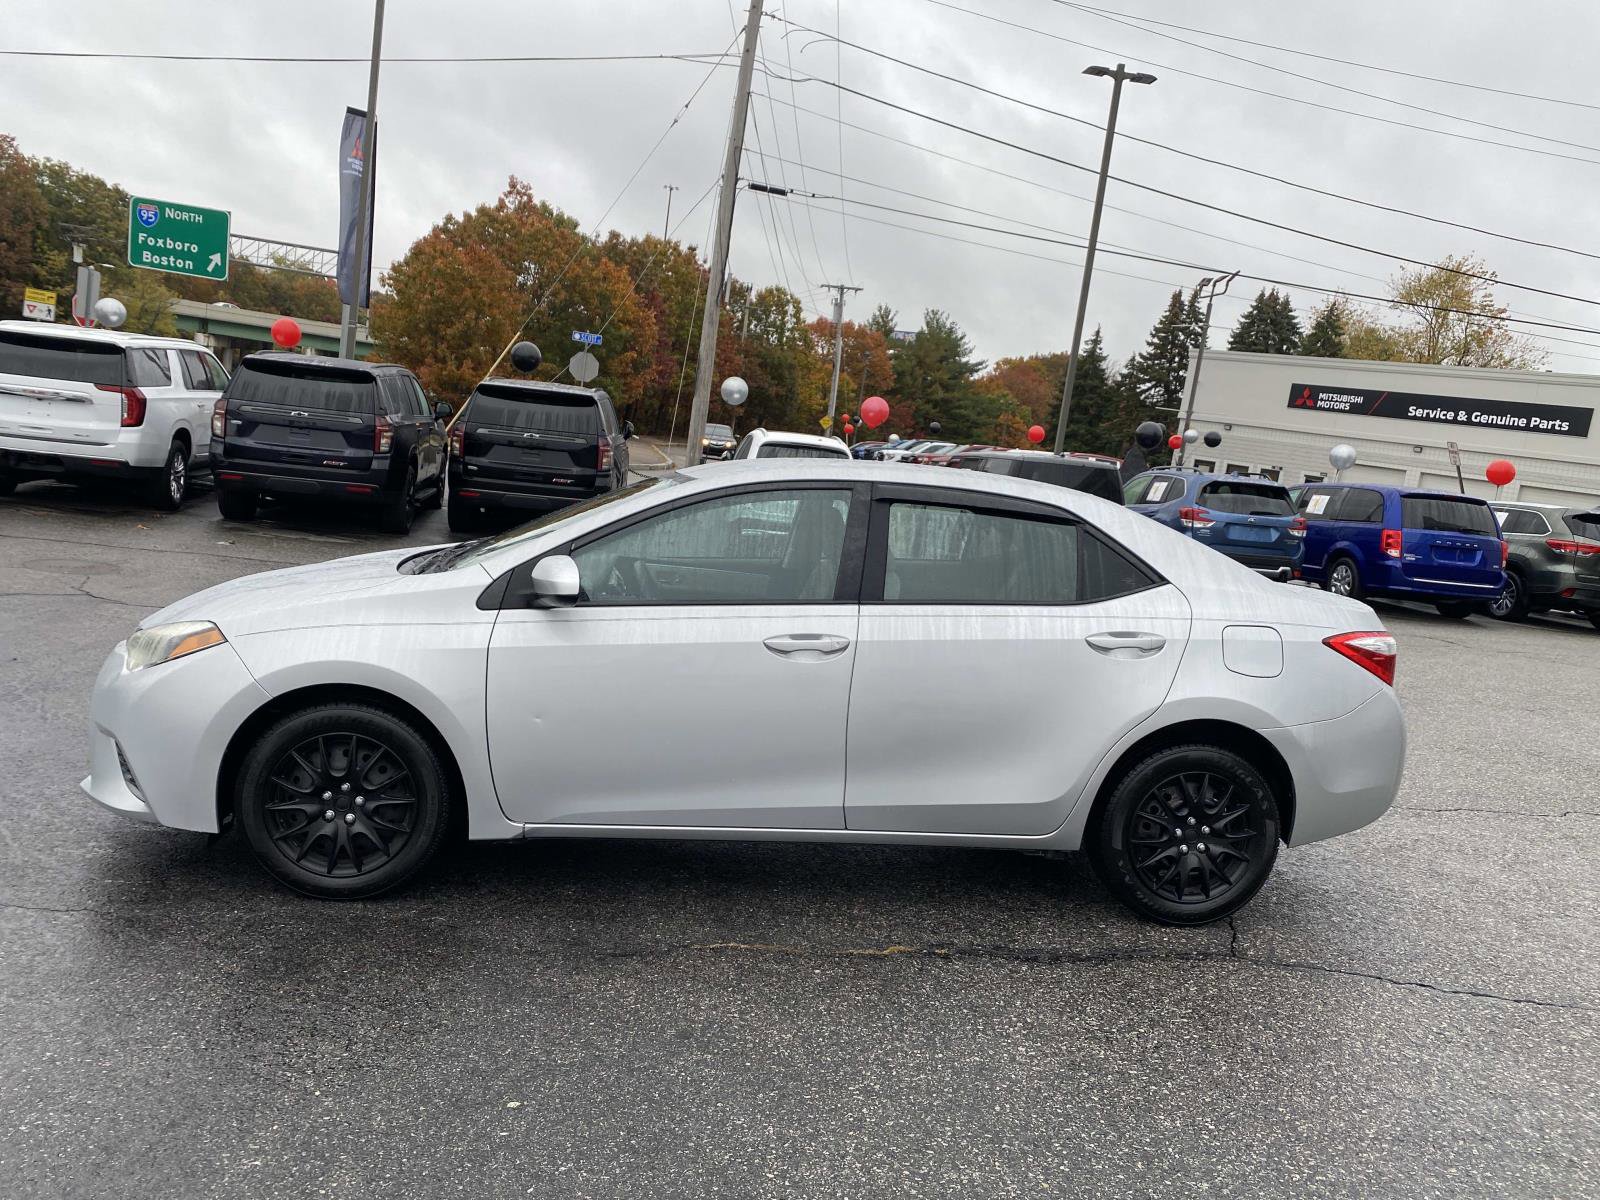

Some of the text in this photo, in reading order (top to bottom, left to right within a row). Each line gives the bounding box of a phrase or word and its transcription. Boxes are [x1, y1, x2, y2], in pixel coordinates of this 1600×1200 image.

[140, 209, 156, 222] 95
[138, 232, 199, 253] Foxboro
[142, 250, 193, 270] Boston
[1316, 400, 1350, 410] MOTORS
[1318, 392, 1364, 404] MITSUBISHI
[1407, 405, 1570, 431] Service & Genuine Parts
